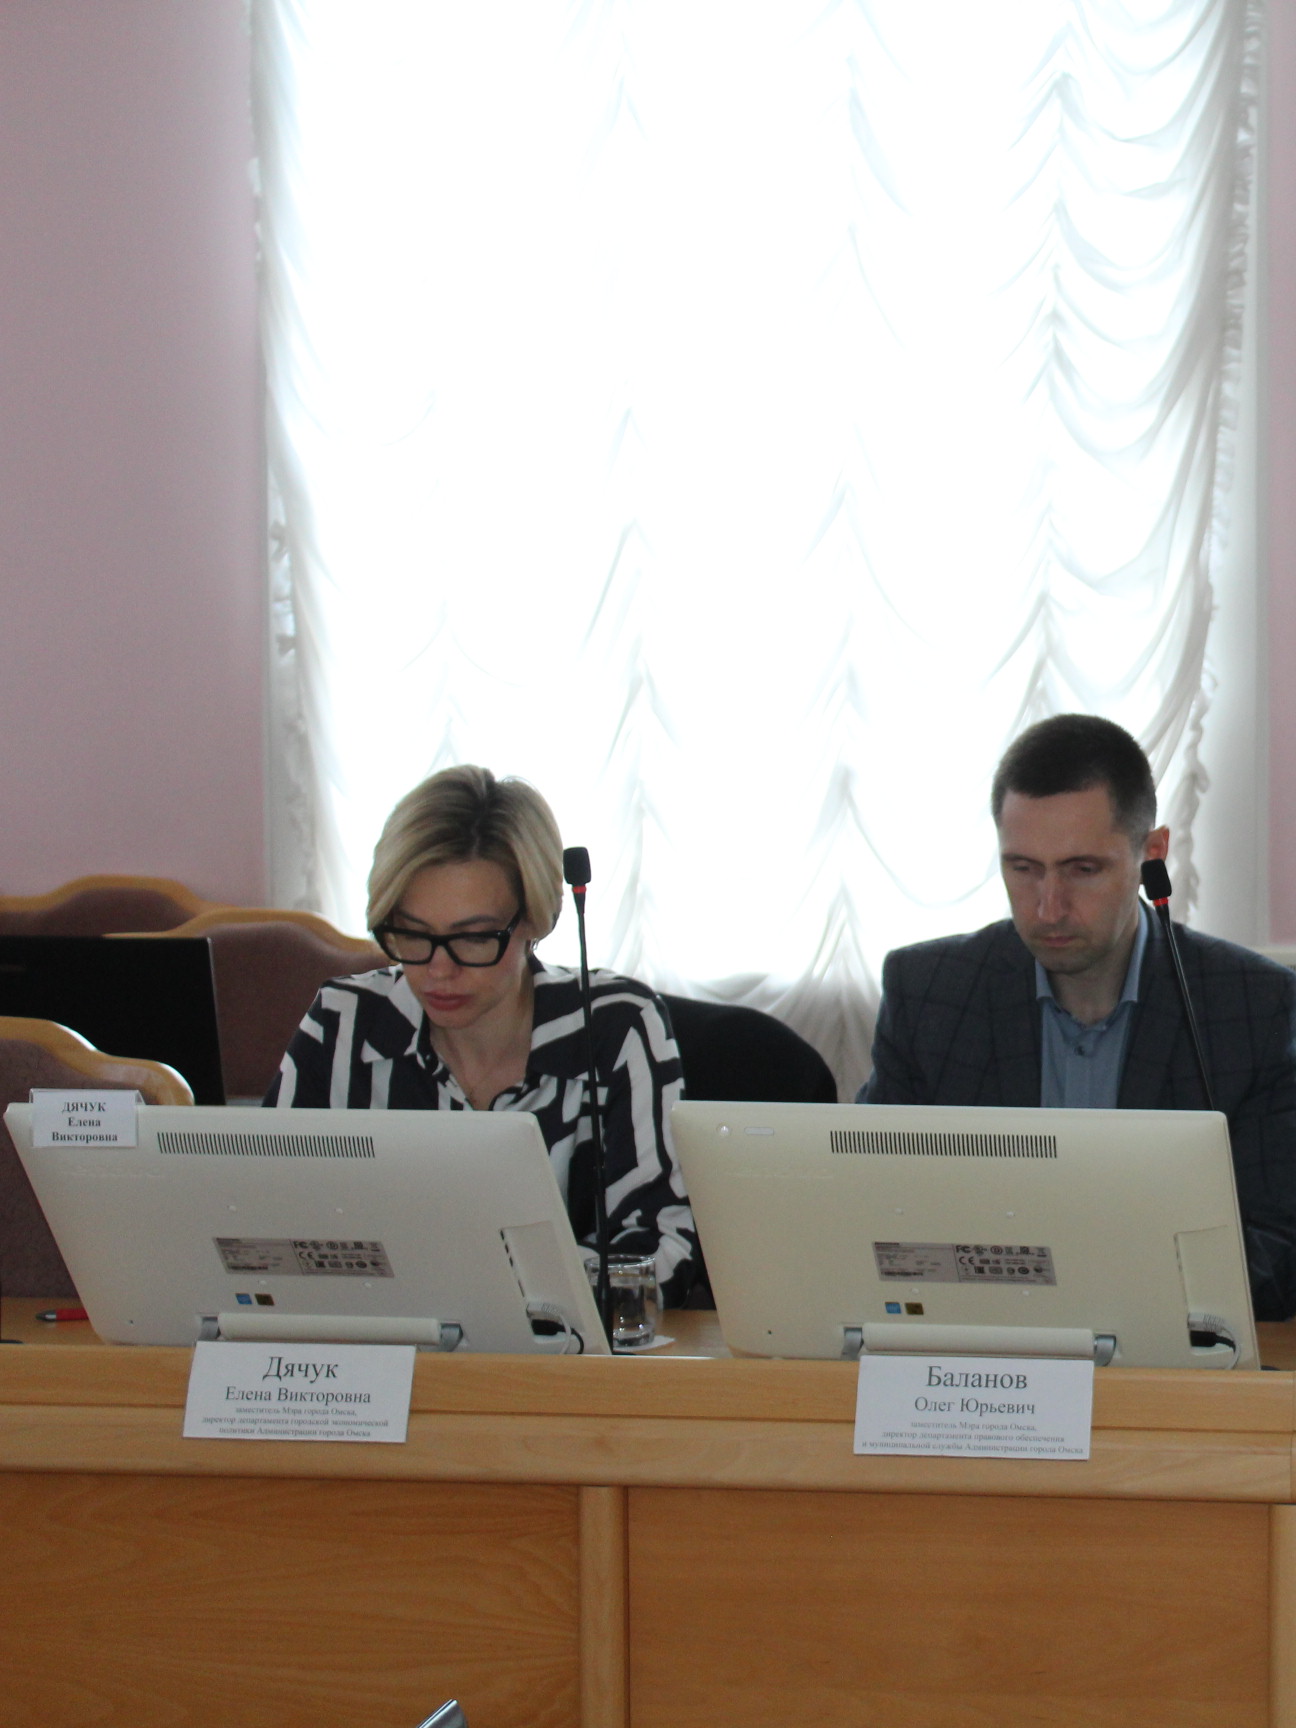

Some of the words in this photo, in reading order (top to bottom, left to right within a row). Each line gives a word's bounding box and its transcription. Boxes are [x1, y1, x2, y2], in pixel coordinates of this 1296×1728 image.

[62, 1102, 106, 1113] ДЯЧУК
[68, 1117, 101, 1127] Елена
[52, 1131, 118, 1144] Викторовна
[262, 1356, 339, 1383] Дячук
[926, 1366, 1028, 1389] Баланов
[225, 1386, 272, 1401] Елена
[277, 1387, 371, 1406] Викторовна
[914, 1396, 955, 1412] Олег
[960, 1398, 1036, 1417] Юрьевич
[303, 1408, 329, 1417] города
[959, 1422, 980, 1430] Мэра
[981, 1423, 1008, 1431] города
[318, 1429, 345, 1437] города
[346, 1429, 371, 1437] Омска
[882, 1431, 918, 1440] директор
[919, 1432, 972, 1440] департамента
[974, 1433, 1014, 1442] правового
[1015, 1433, 1065, 1442] обеспечения
[1029, 1445, 1057, 1453] города
[1057, 1445, 1084, 1454] Омска
